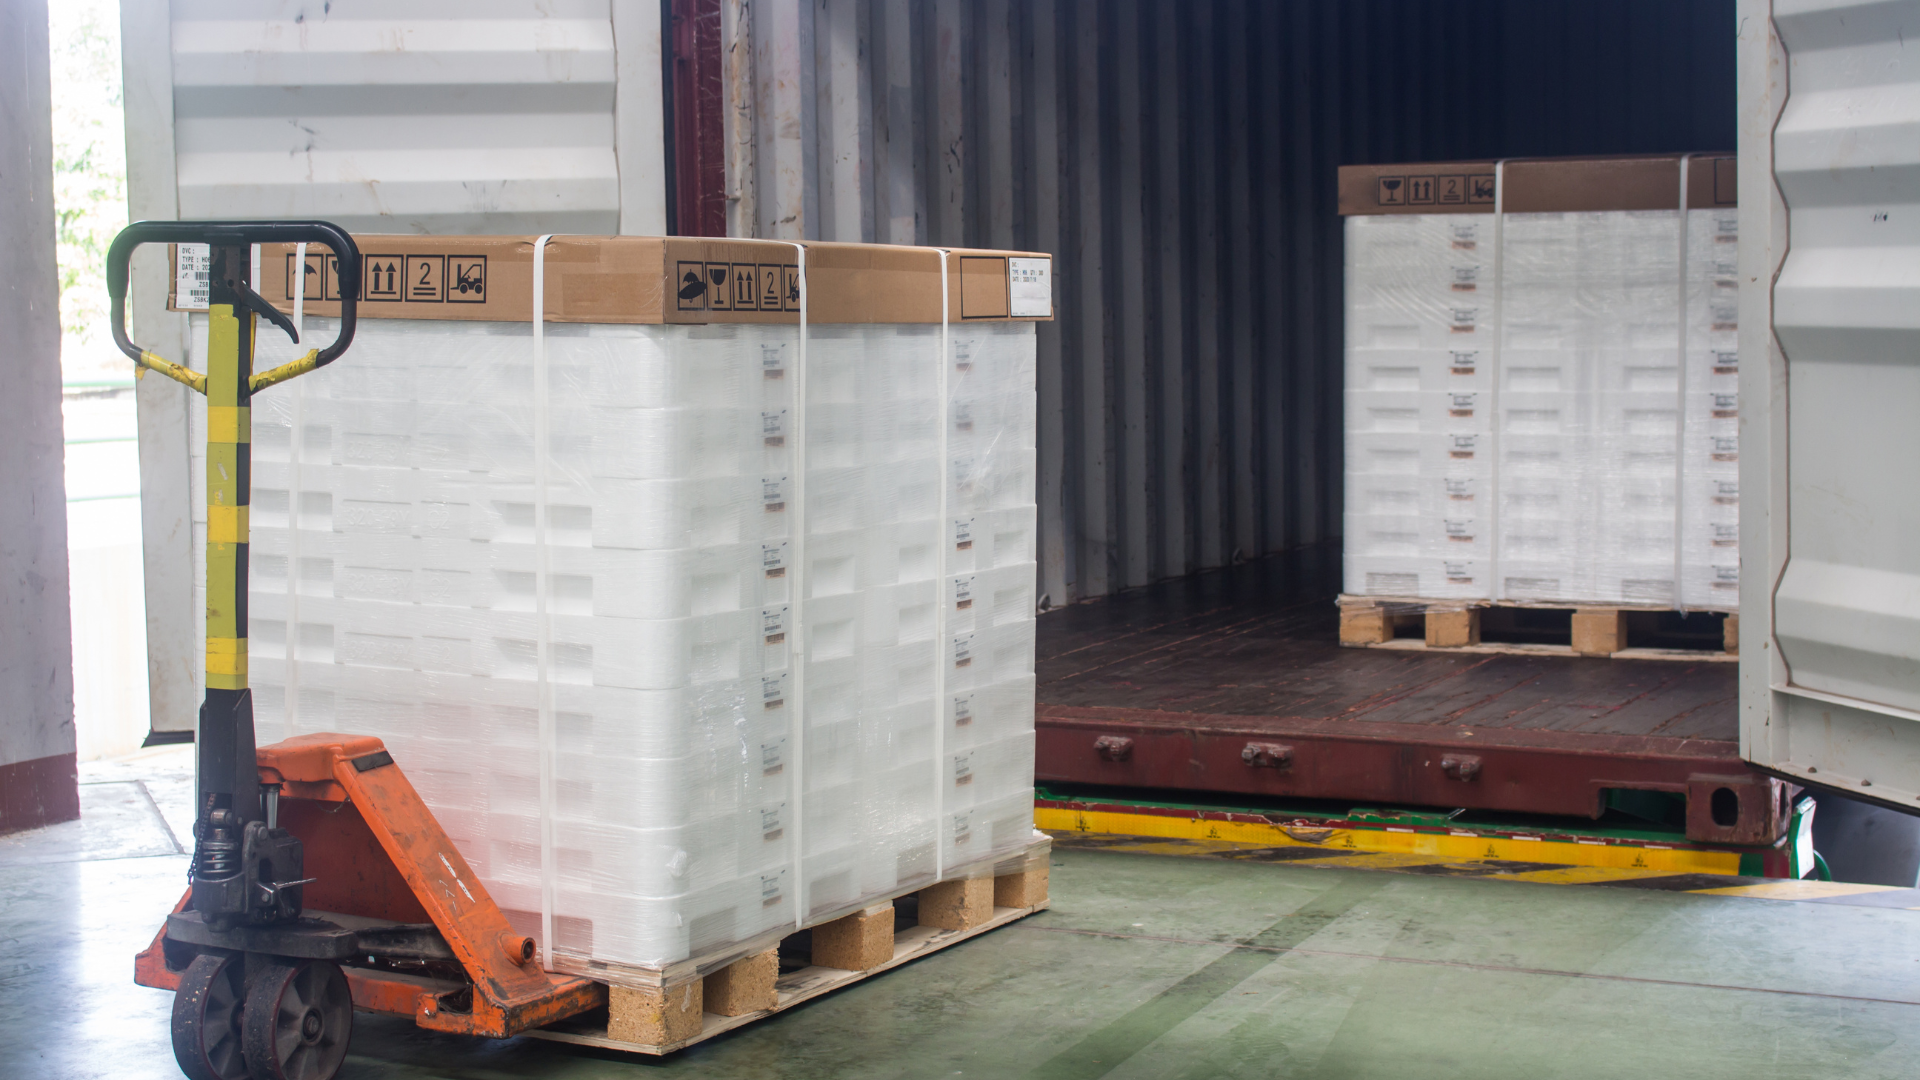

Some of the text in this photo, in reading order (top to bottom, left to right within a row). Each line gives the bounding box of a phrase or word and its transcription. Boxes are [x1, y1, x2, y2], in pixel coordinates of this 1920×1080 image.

[1448, 180, 1456, 194] 2
[420, 262, 430, 285] 2
[767, 271, 774, 294] 2
